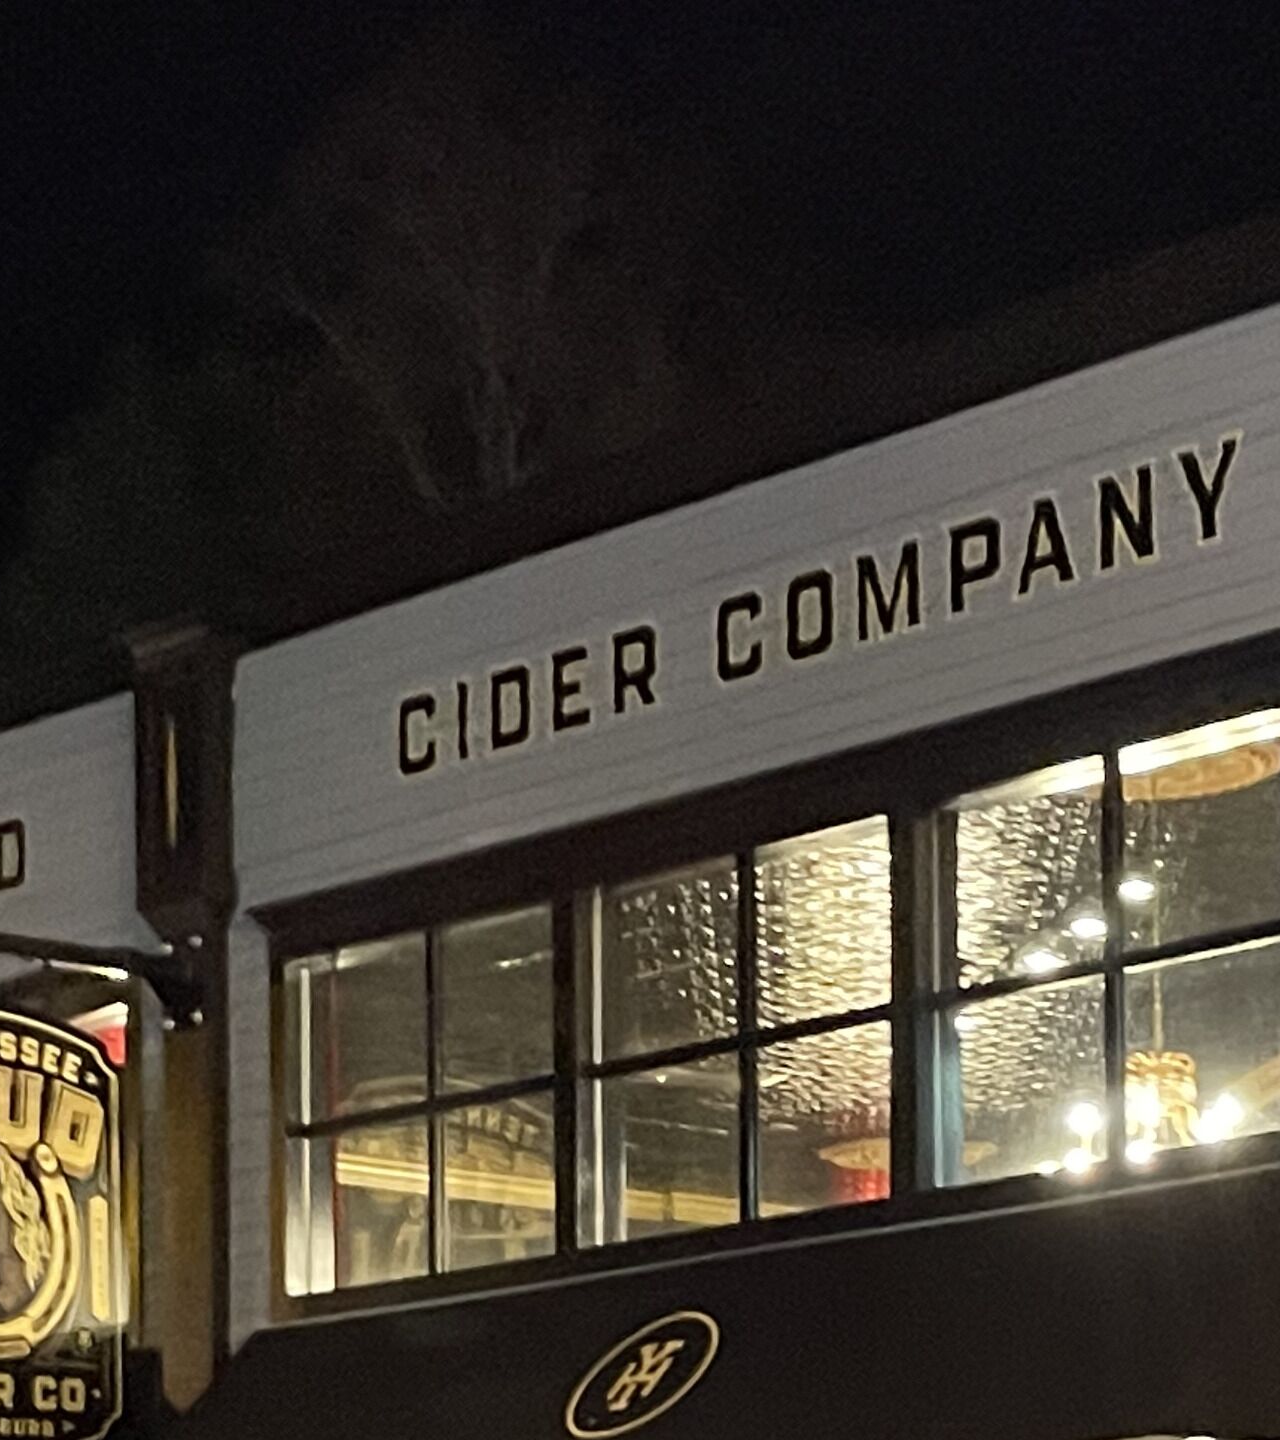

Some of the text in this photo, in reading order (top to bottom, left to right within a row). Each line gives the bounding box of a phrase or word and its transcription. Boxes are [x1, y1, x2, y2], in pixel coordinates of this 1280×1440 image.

[397, 429, 1244, 776] CIDER COMPANY
[33, 1374, 87, 1413] CO
